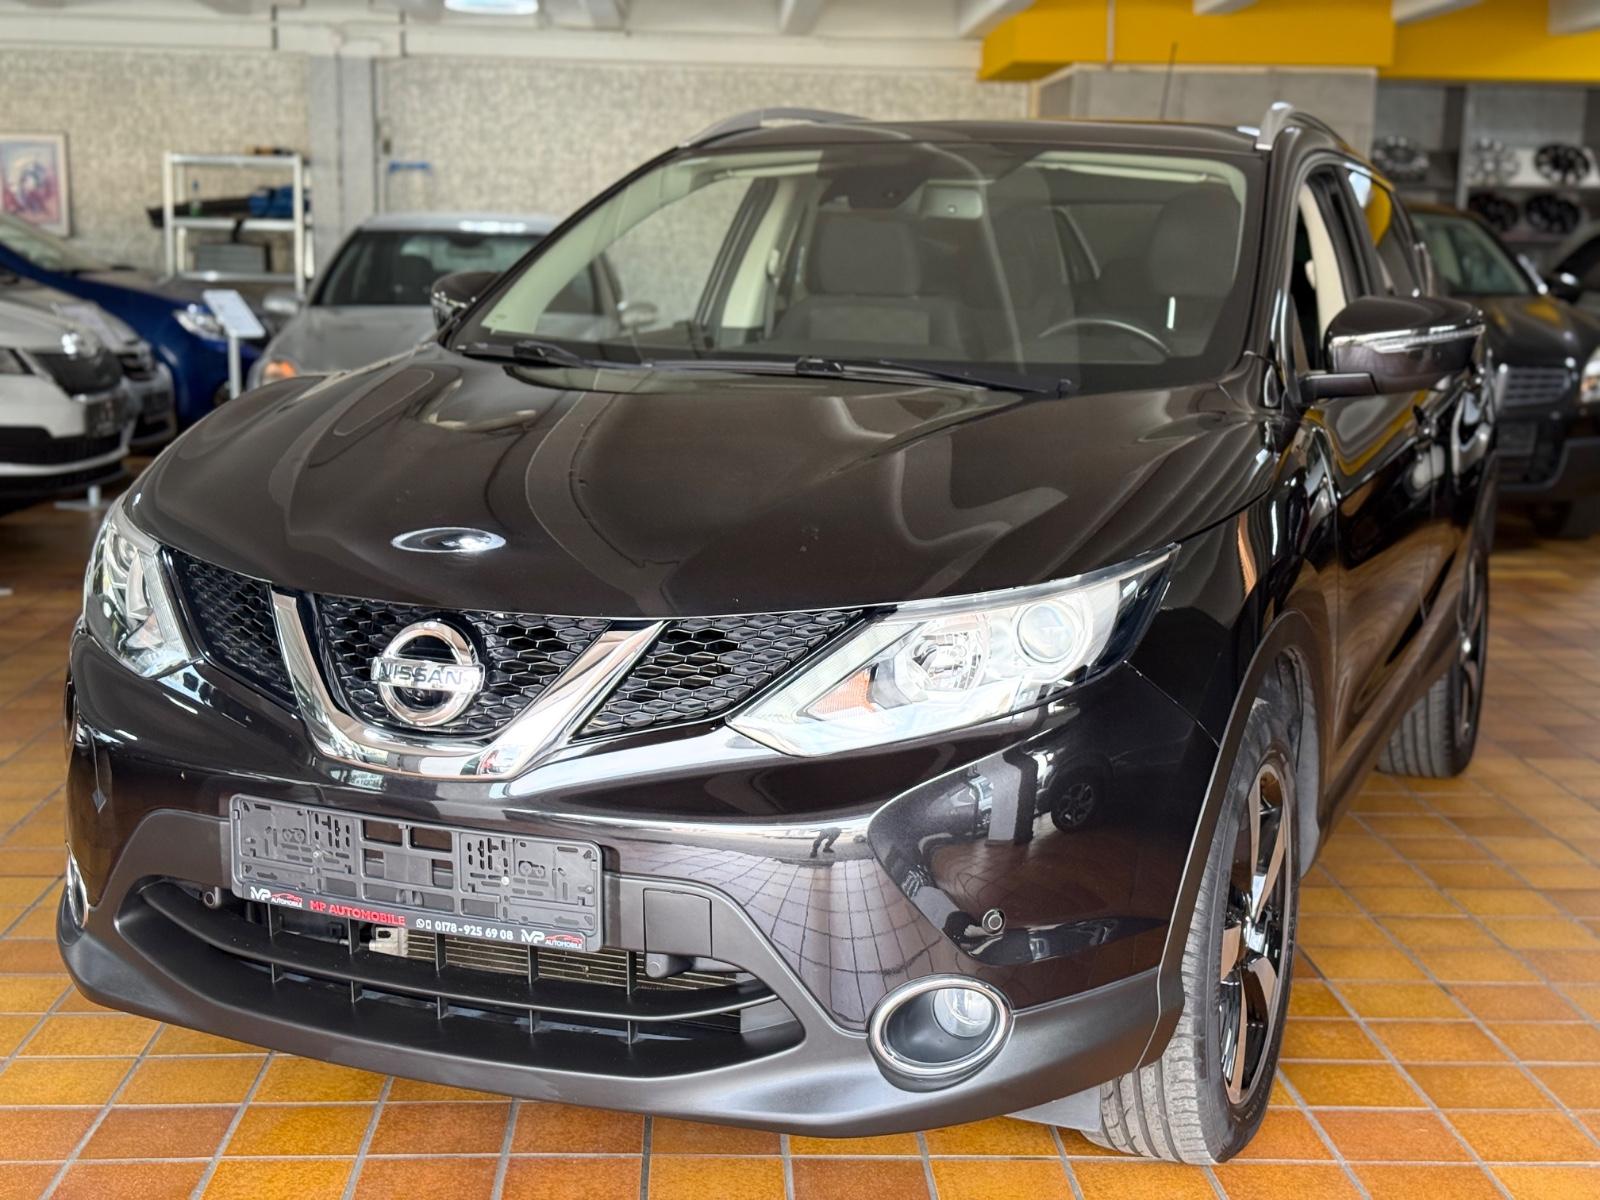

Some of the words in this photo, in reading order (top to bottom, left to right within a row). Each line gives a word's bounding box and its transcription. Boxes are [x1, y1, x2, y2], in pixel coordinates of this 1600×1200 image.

[377, 661, 463, 685] NISSAN
[271, 897, 303, 908] AUTOMOBILE
[309, 900, 327, 913] MP
[328, 904, 406, 926] AUTOMOBILE
[485, 927, 498, 939] 69
[500, 929, 513, 941] 08
[545, 939, 583, 949] AUTOMOBILE
